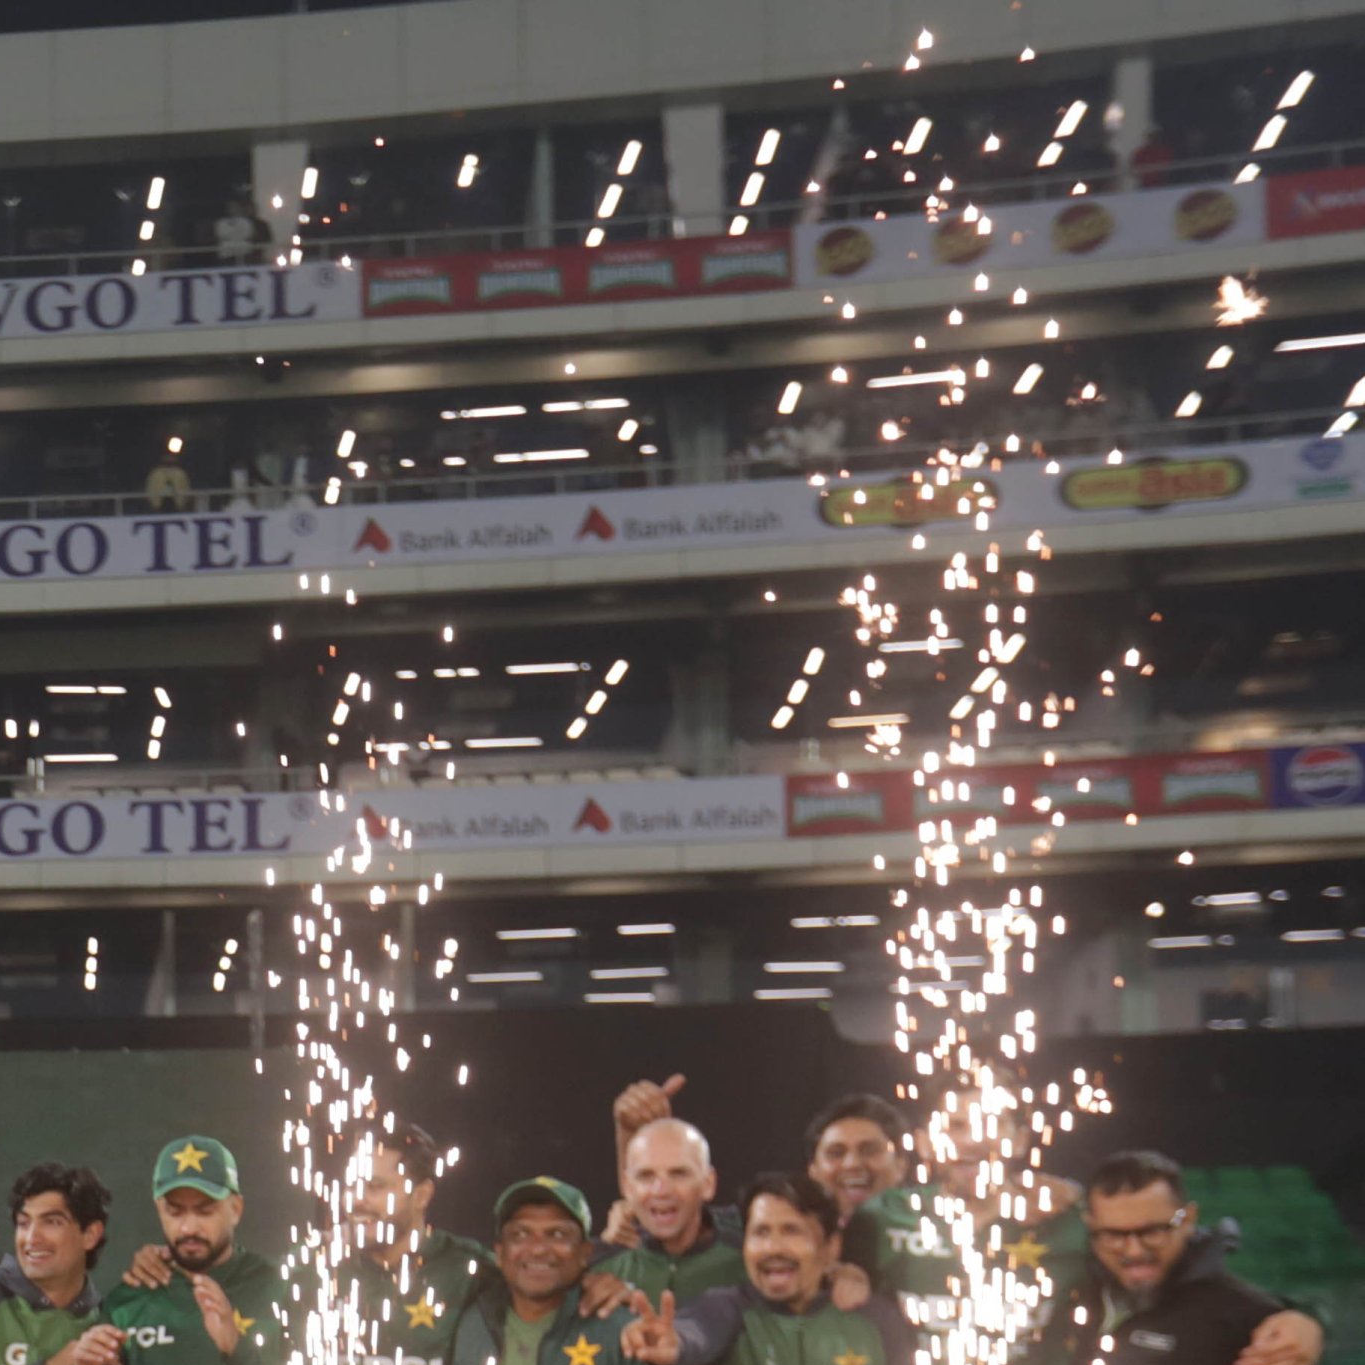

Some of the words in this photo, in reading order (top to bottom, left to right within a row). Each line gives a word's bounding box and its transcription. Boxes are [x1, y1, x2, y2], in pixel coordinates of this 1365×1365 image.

[159, 270, 317, 325] TEL
[132, 516, 294, 572] TEL
[129, 797, 291, 854] TEL
